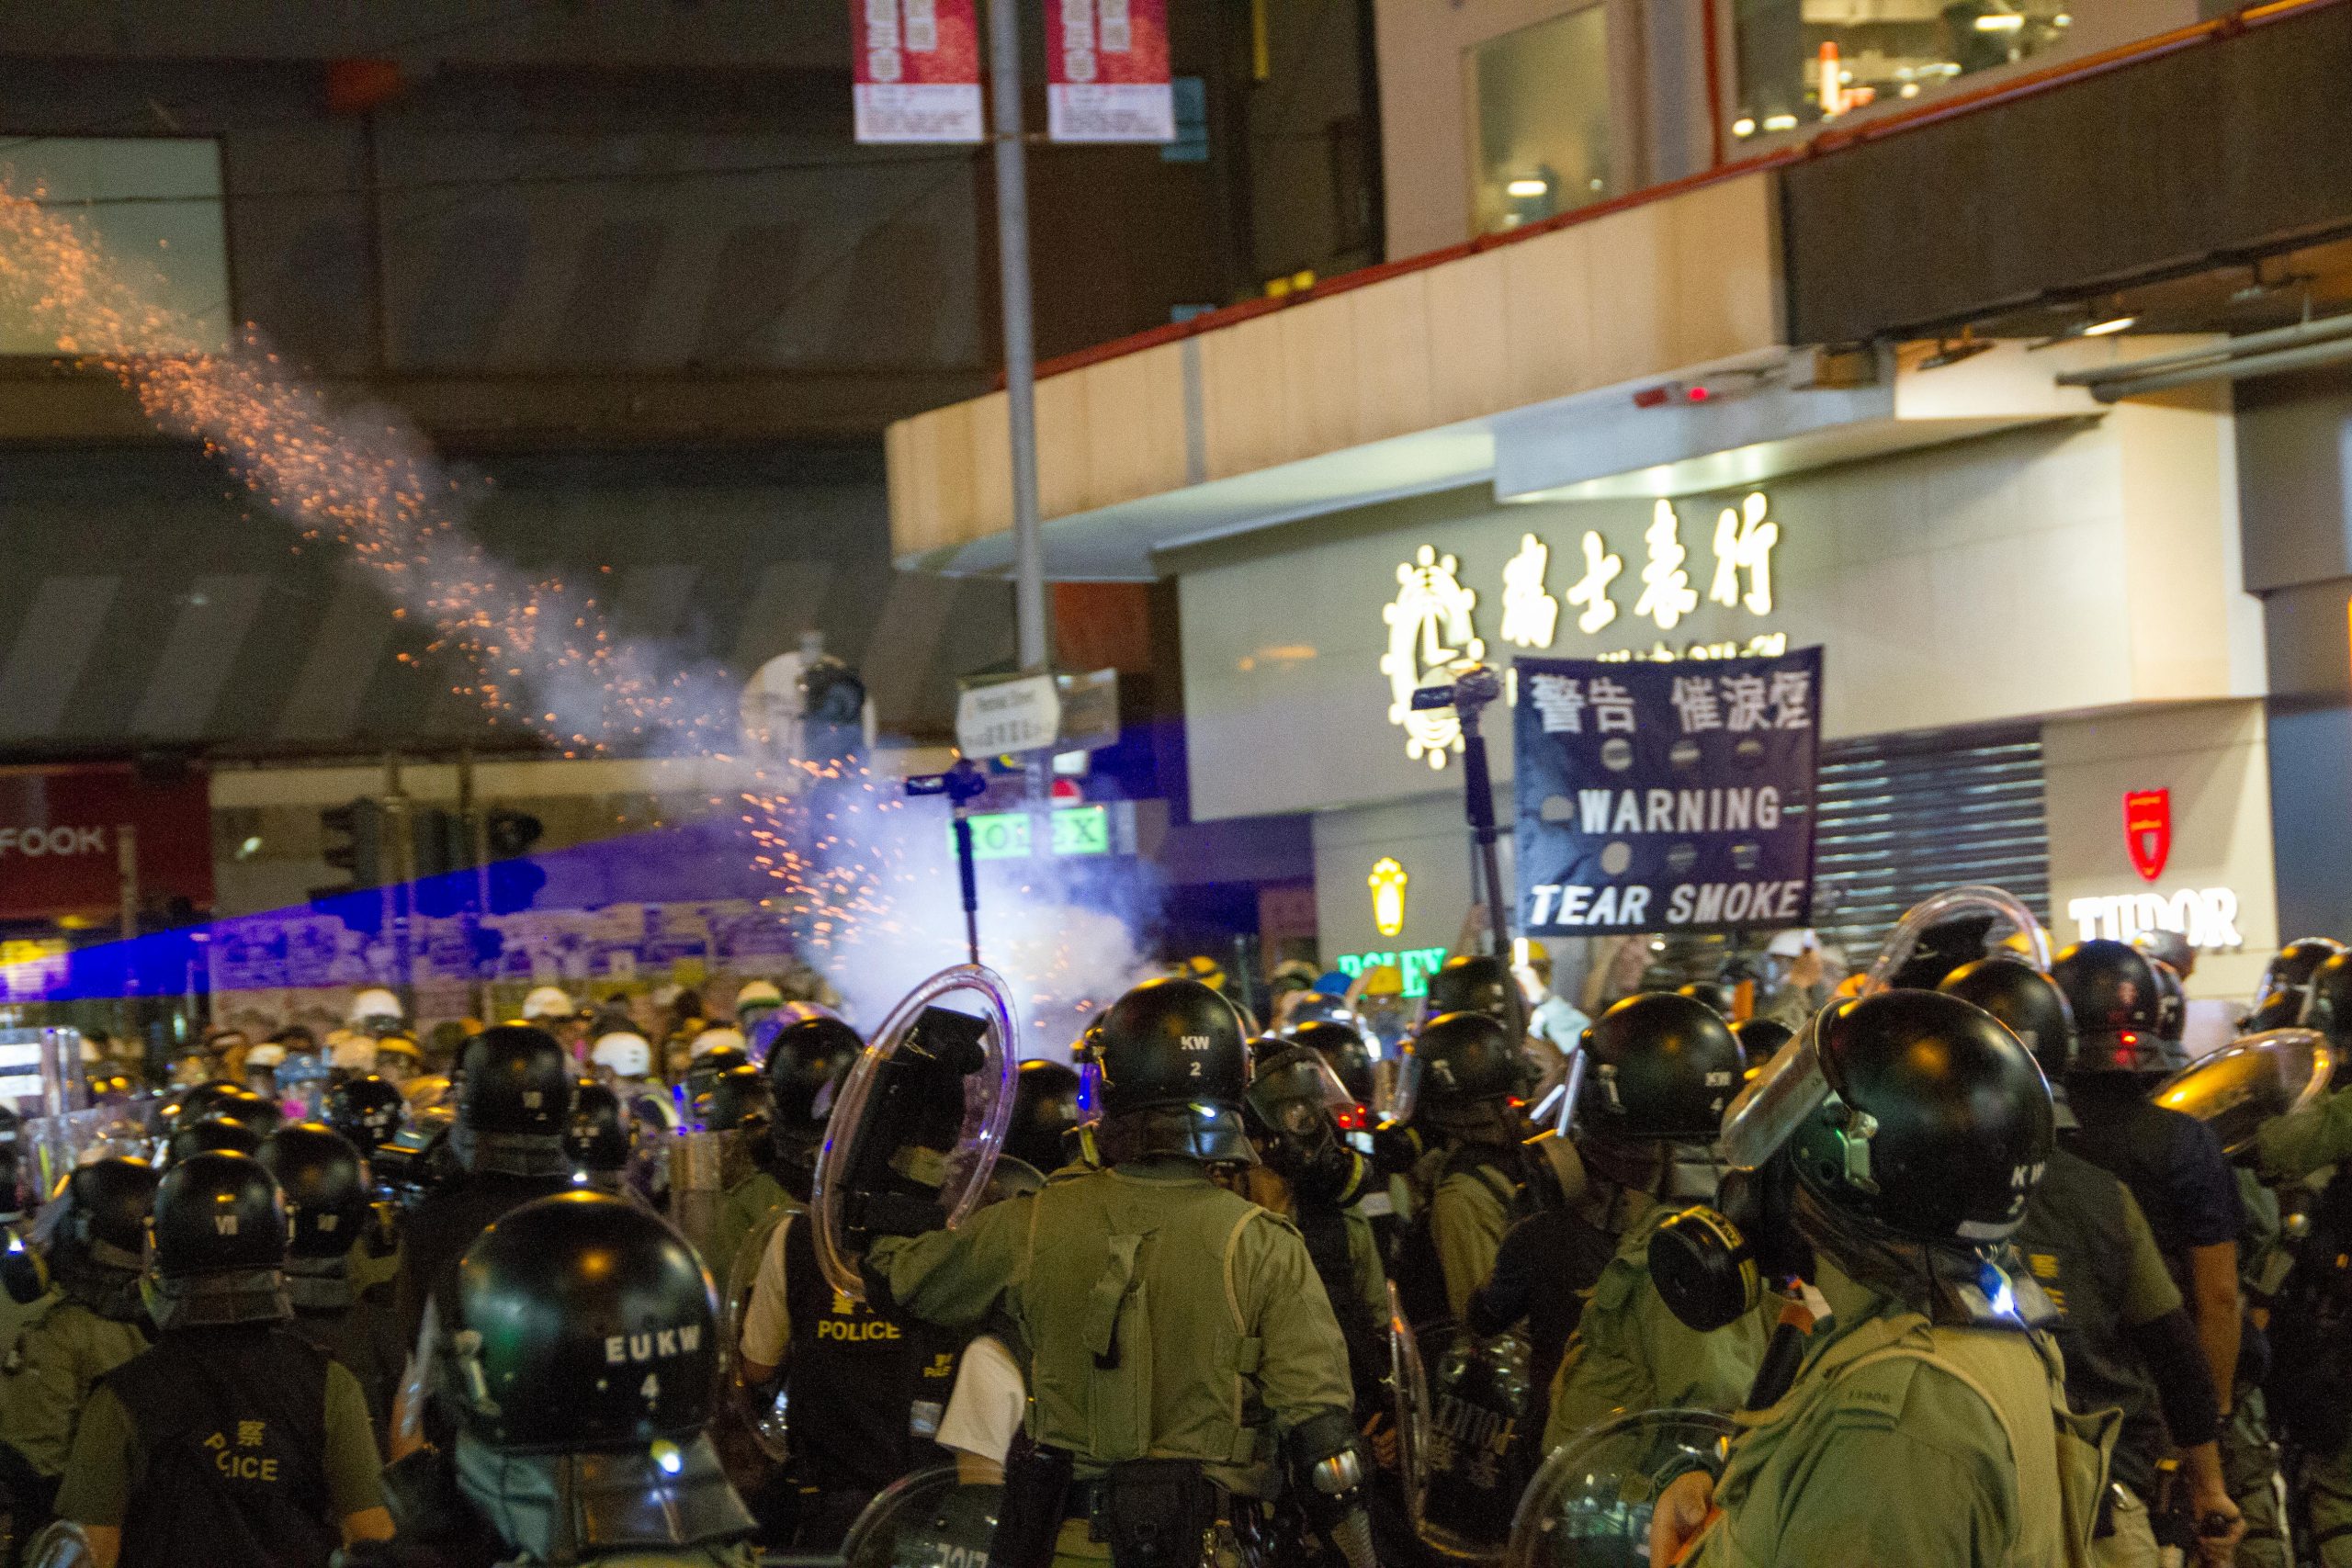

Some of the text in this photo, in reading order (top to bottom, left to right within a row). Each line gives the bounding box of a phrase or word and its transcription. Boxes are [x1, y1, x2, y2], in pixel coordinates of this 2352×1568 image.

[1529, 672, 1636, 734] 警告
[1578, 786, 1780, 834] WARNING
[0, 826, 107, 856] FOOK
[1530, 880, 1805, 925] TEAR SMOKE
[2068, 886, 2242, 947] TUDOR
[1181, 1035, 1210, 1051] KW
[1189, 1061, 1202, 1077] 2
[605, 1324, 702, 1364] EUKW
[818, 1320, 902, 1341] POLICE
[639, 1372, 660, 1398] 4
